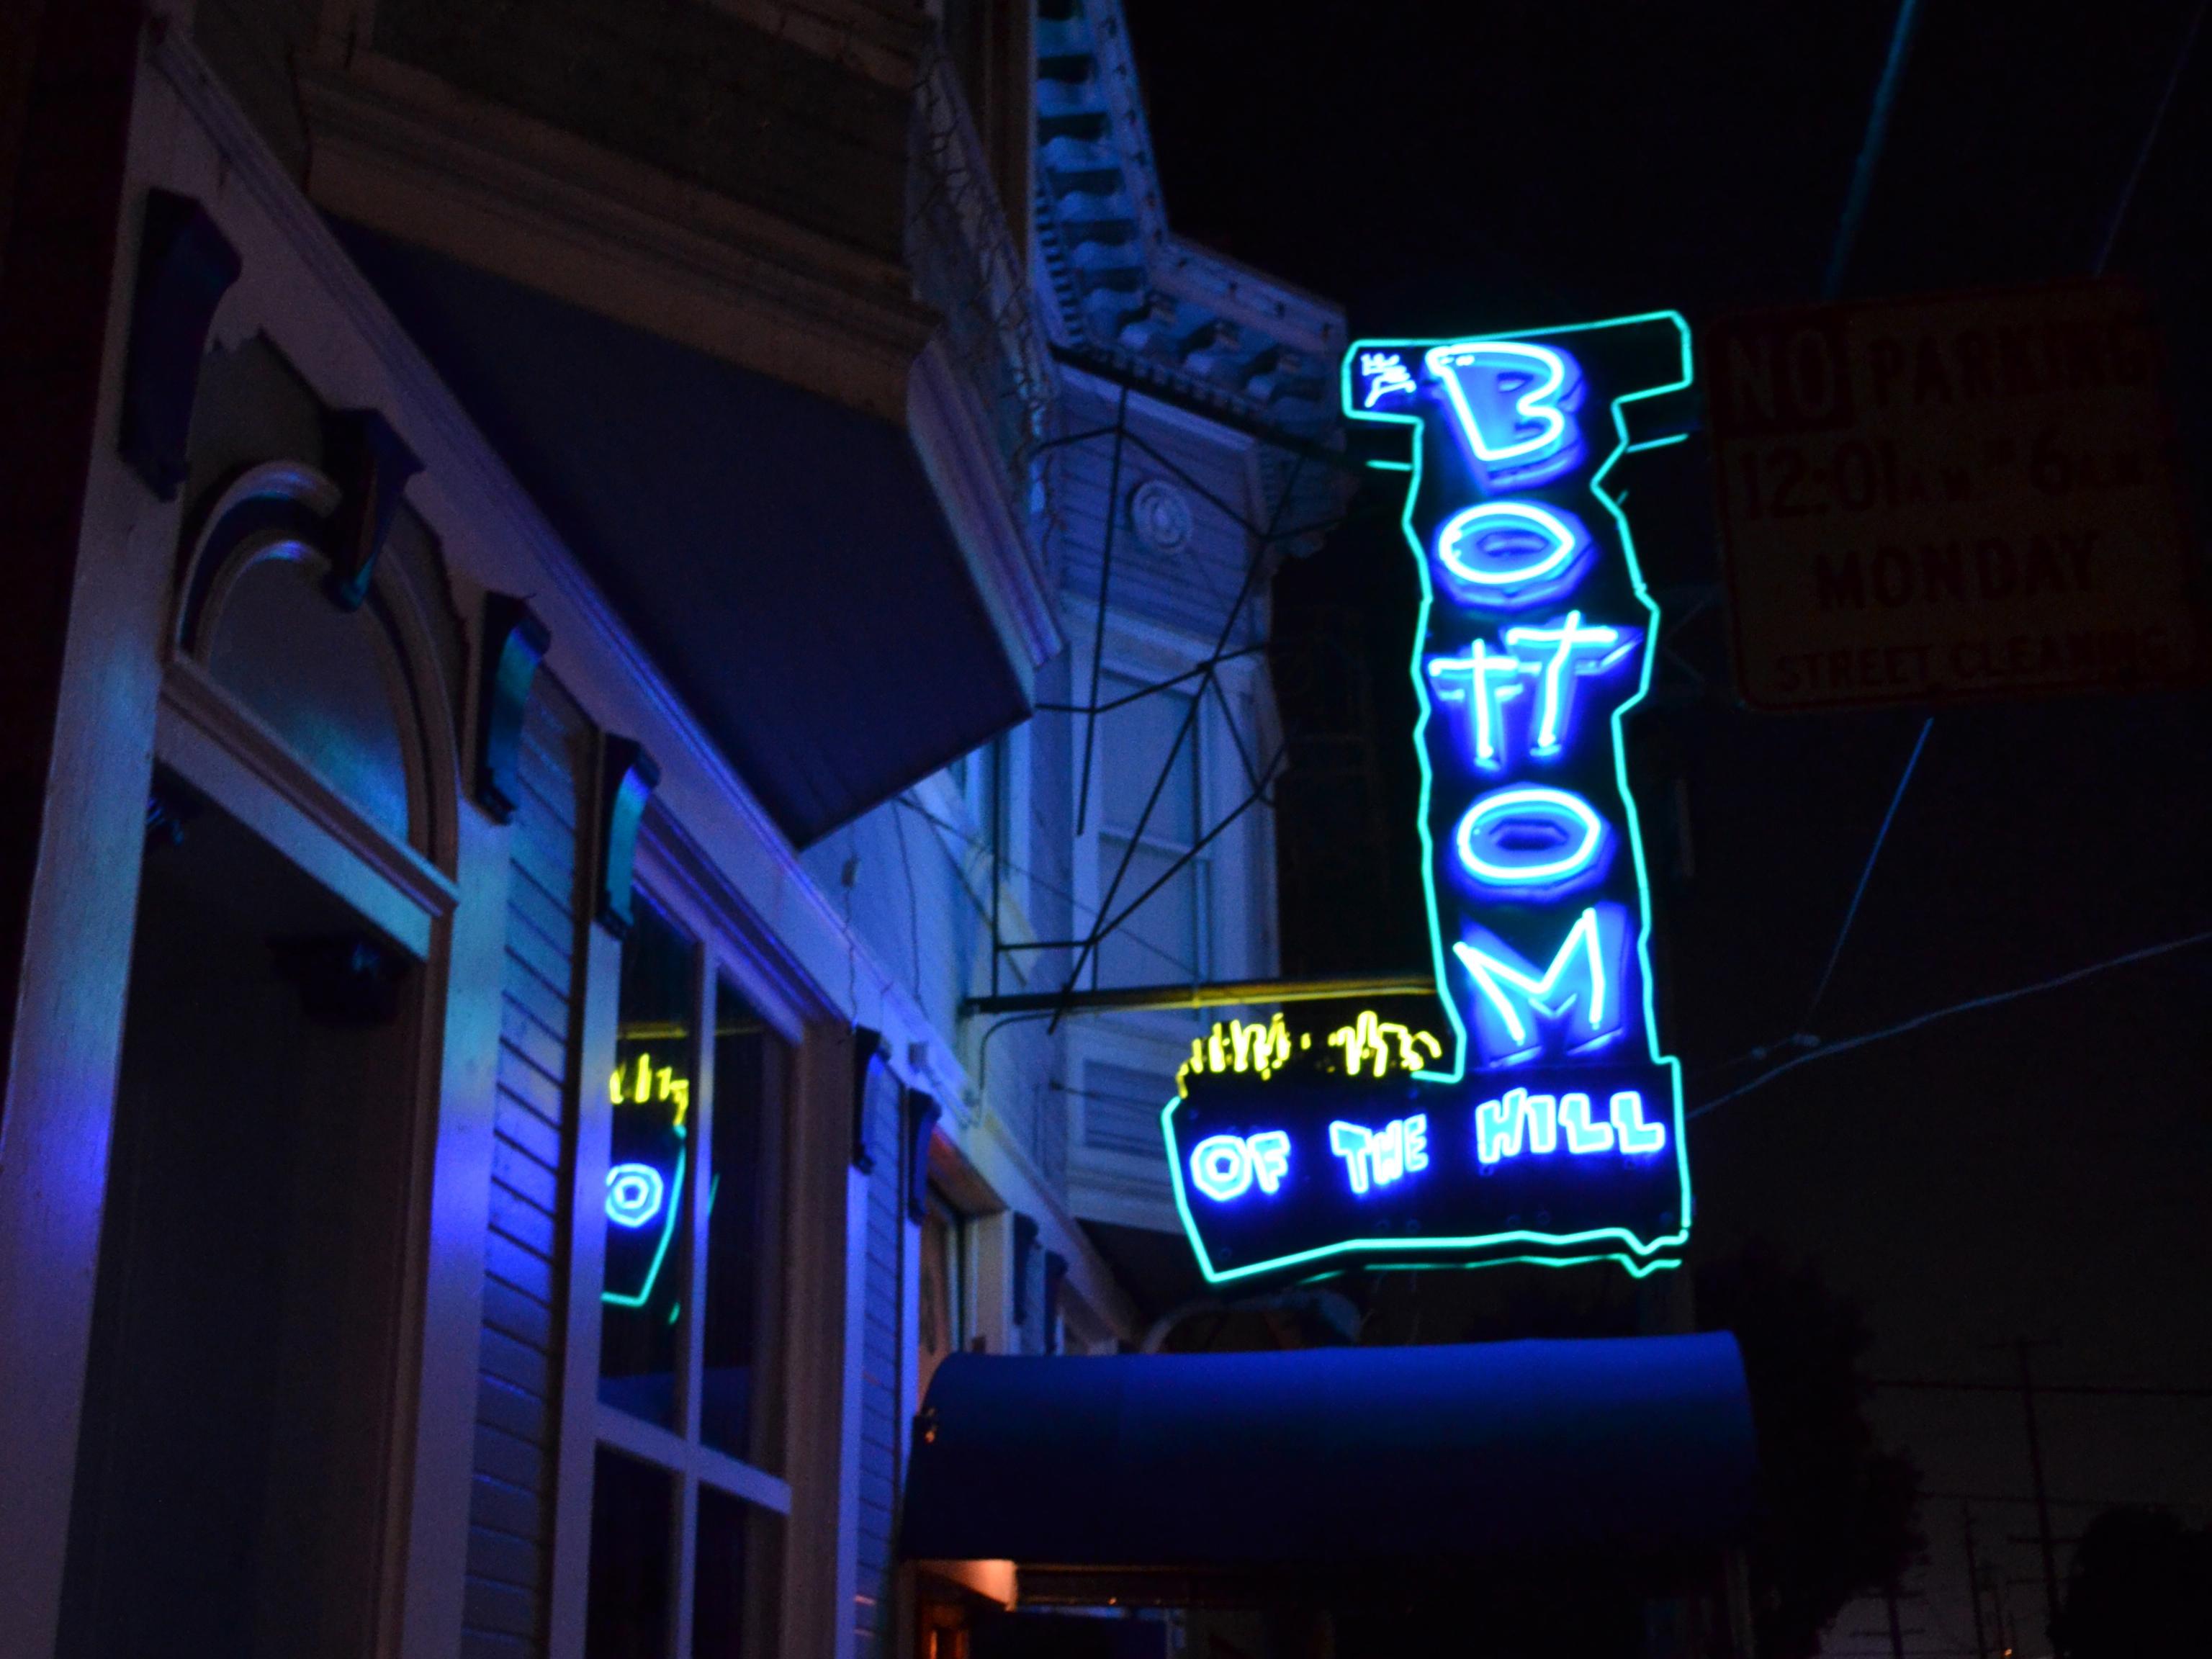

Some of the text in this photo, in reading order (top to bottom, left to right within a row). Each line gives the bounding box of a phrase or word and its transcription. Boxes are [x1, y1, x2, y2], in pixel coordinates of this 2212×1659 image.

[1730, 329, 1836, 420] NO
[1813, 531, 2099, 610] MONDAY
[1422, 339, 1643, 1069] BOTTOM
[1775, 643, 1933, 693] STREET
[1190, 1087, 1665, 1202] OF THE HILL
